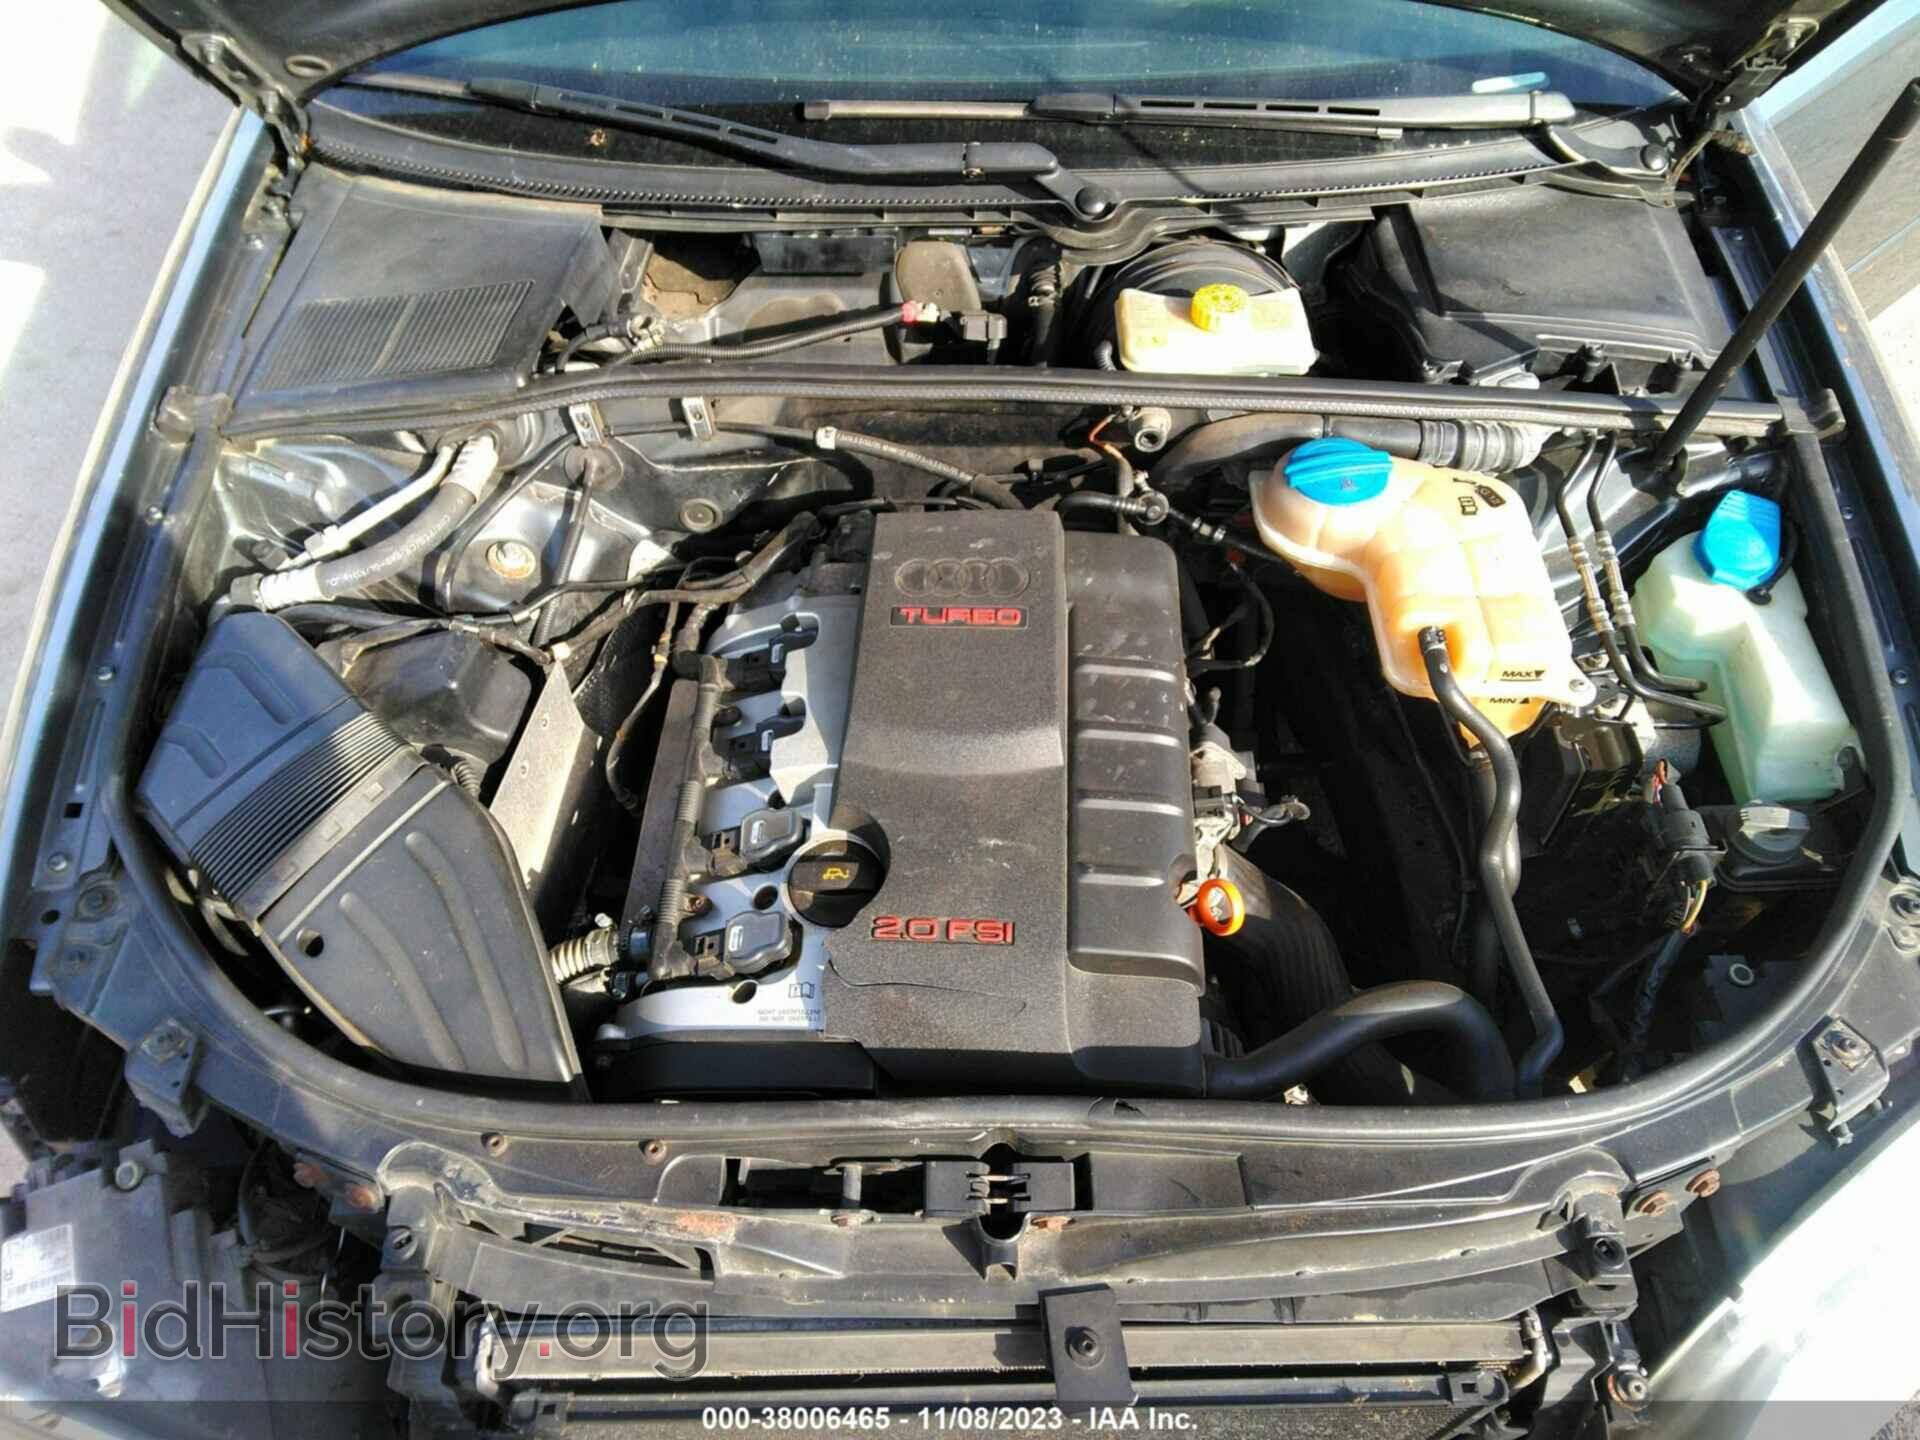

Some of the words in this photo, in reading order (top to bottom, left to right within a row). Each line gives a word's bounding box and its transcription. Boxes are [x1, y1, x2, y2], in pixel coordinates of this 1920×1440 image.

[898, 607, 1022, 625] TURBO
[1501, 669, 1534, 678] MAX
[872, 915, 940, 943] 2.0
[946, 918, 1015, 945] FSI
